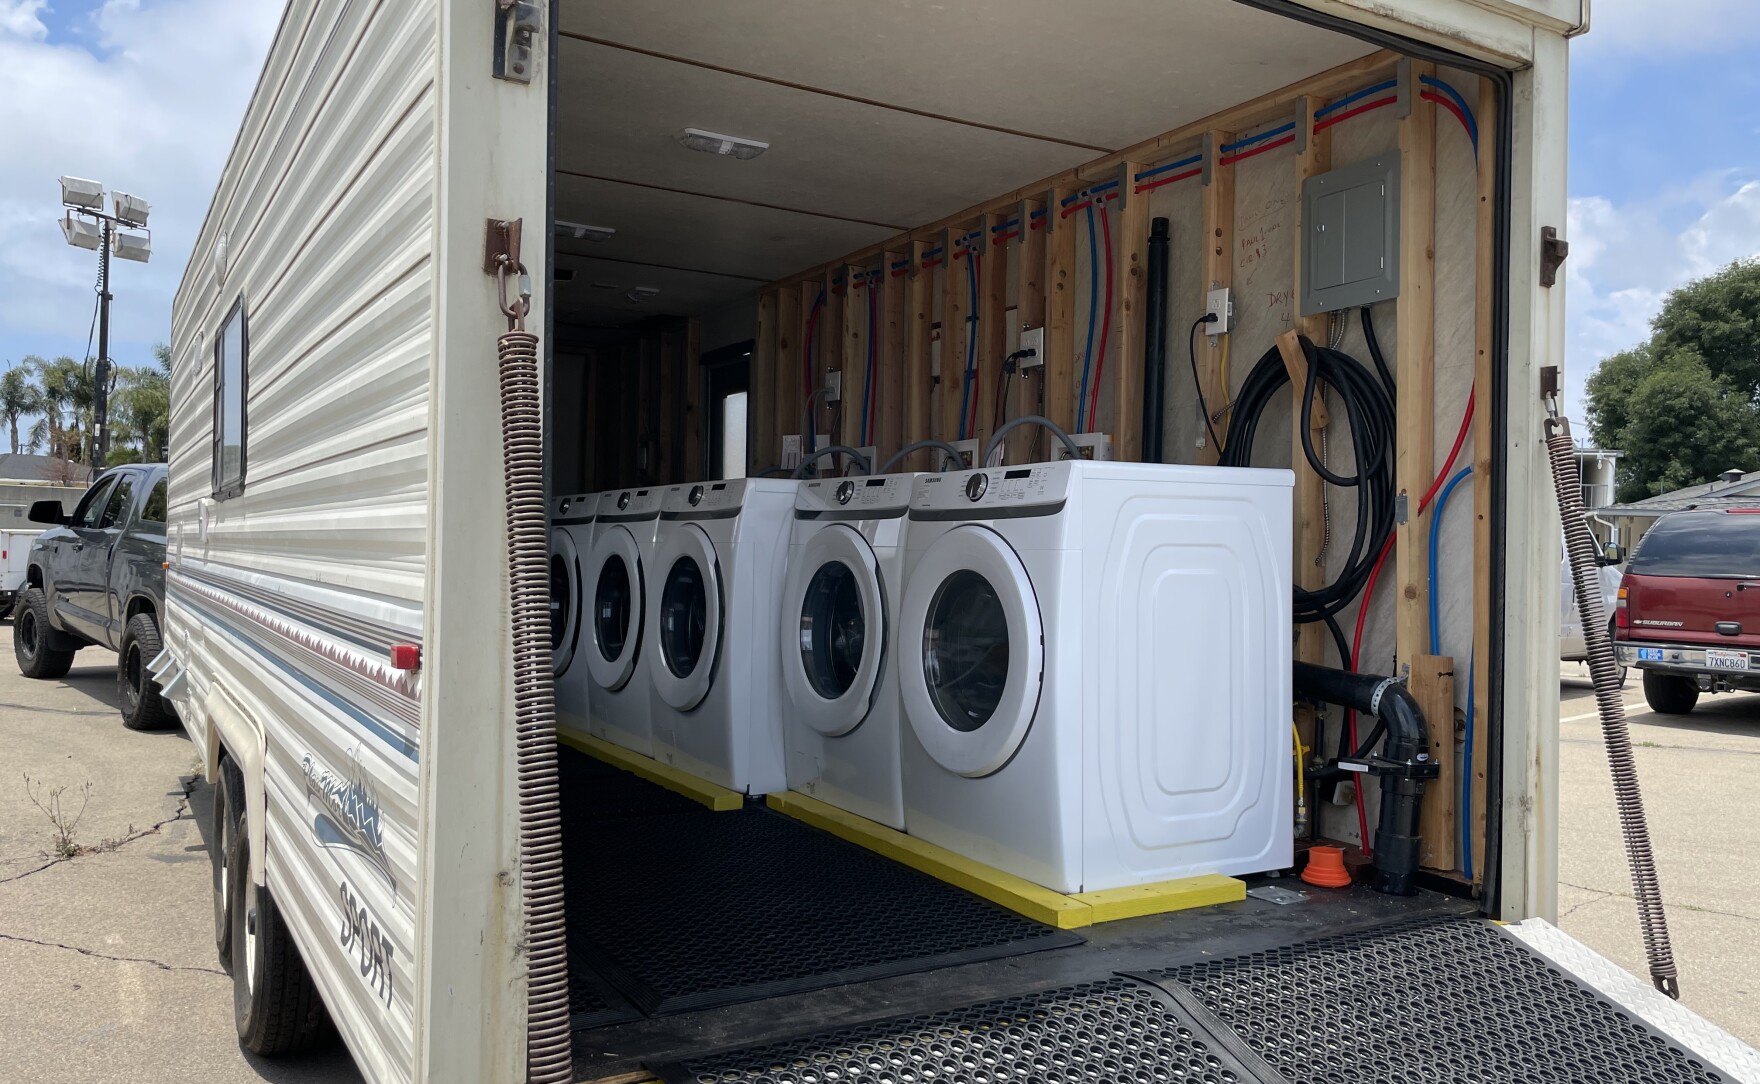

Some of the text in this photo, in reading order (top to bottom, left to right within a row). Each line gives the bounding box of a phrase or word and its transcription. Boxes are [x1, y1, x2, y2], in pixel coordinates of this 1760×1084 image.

[1642, 619, 1684, 627] SUBURBAN
[1708, 656, 1746, 669] 7XNC860
[340, 881, 394, 1011] SPORT
